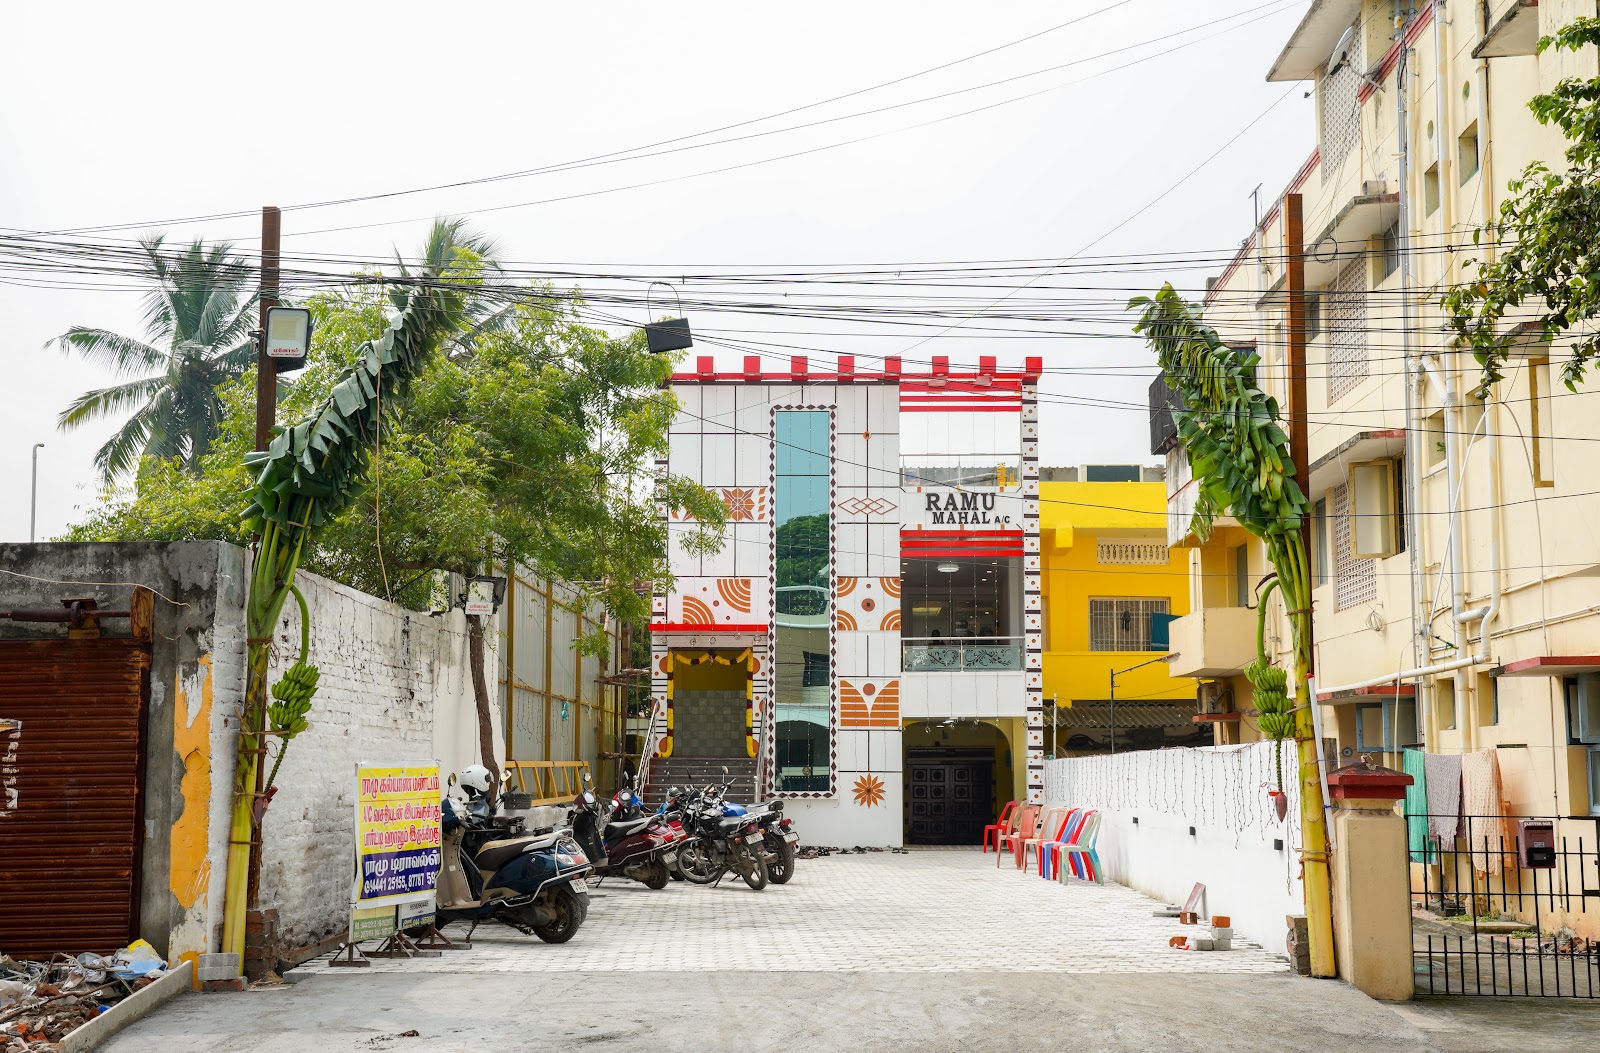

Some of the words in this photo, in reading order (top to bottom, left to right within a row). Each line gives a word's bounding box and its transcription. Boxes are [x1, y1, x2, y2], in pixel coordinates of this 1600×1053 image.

[925, 493, 996, 511] RAMU
[932, 511, 991, 524] MAHAL
[994, 515, 1011, 524] A/C
[362, 778, 379, 798] ராமு
[365, 859, 389, 876] ராமு
[408, 873, 424, 888] 87787
